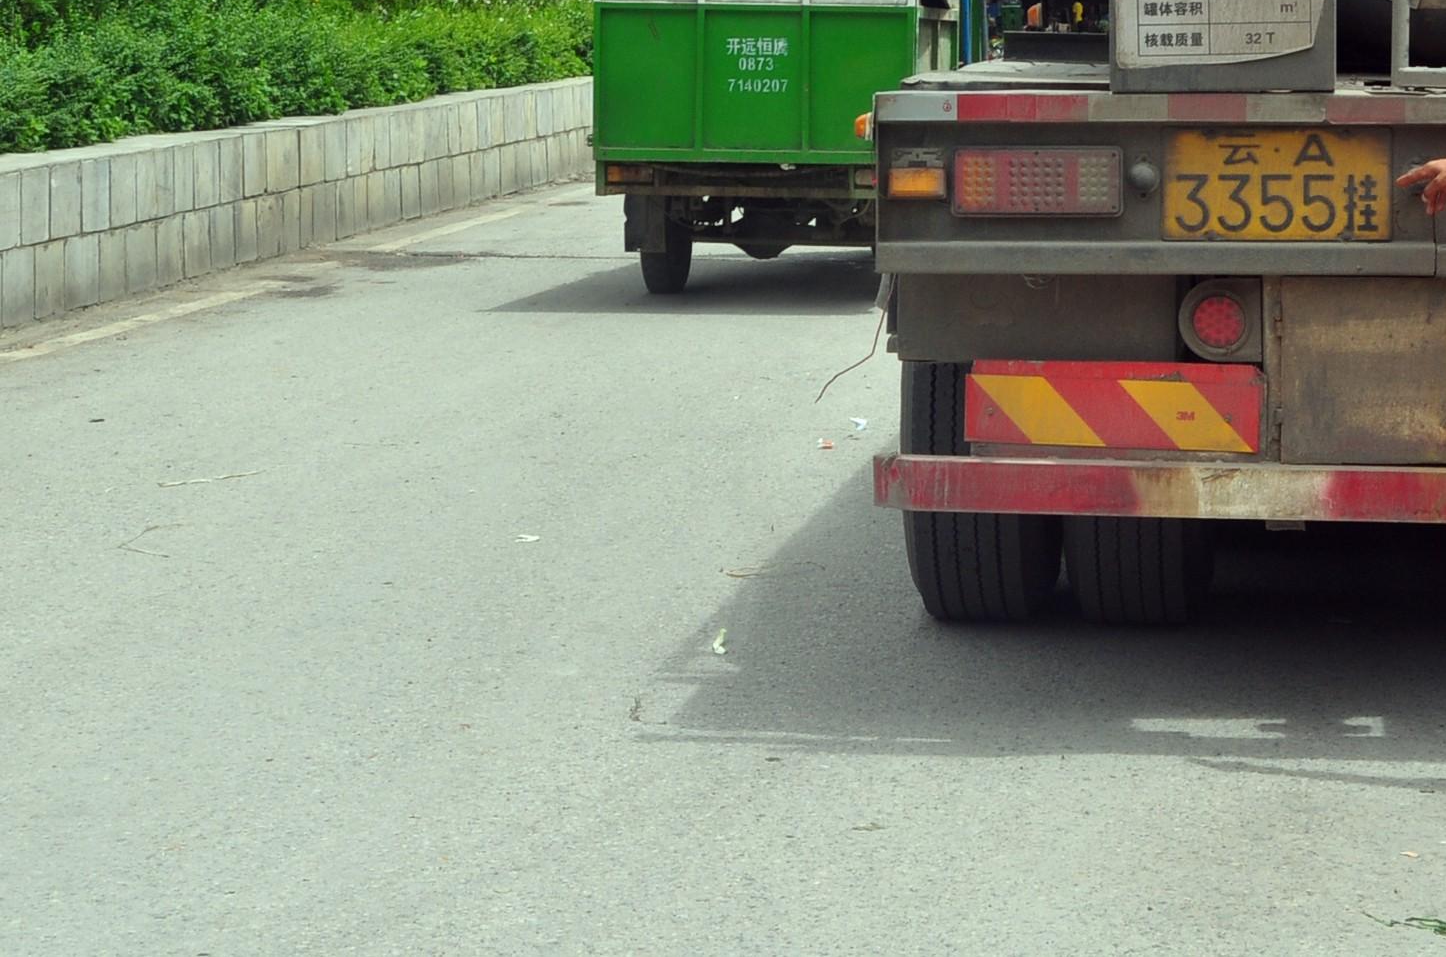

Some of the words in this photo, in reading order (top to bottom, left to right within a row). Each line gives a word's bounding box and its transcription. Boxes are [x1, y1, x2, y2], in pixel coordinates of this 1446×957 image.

[1143, 1, 1204, 17] 罐体容积
[1144, 32, 1204, 48] 核载质量
[1245, 32, 1262, 44] 32
[1265, 31, 1275, 44] T
[738, 57, 774, 71] 0873
[727, 78, 788, 93] 7140207
[1174, 173, 1379, 233] 3355挂
